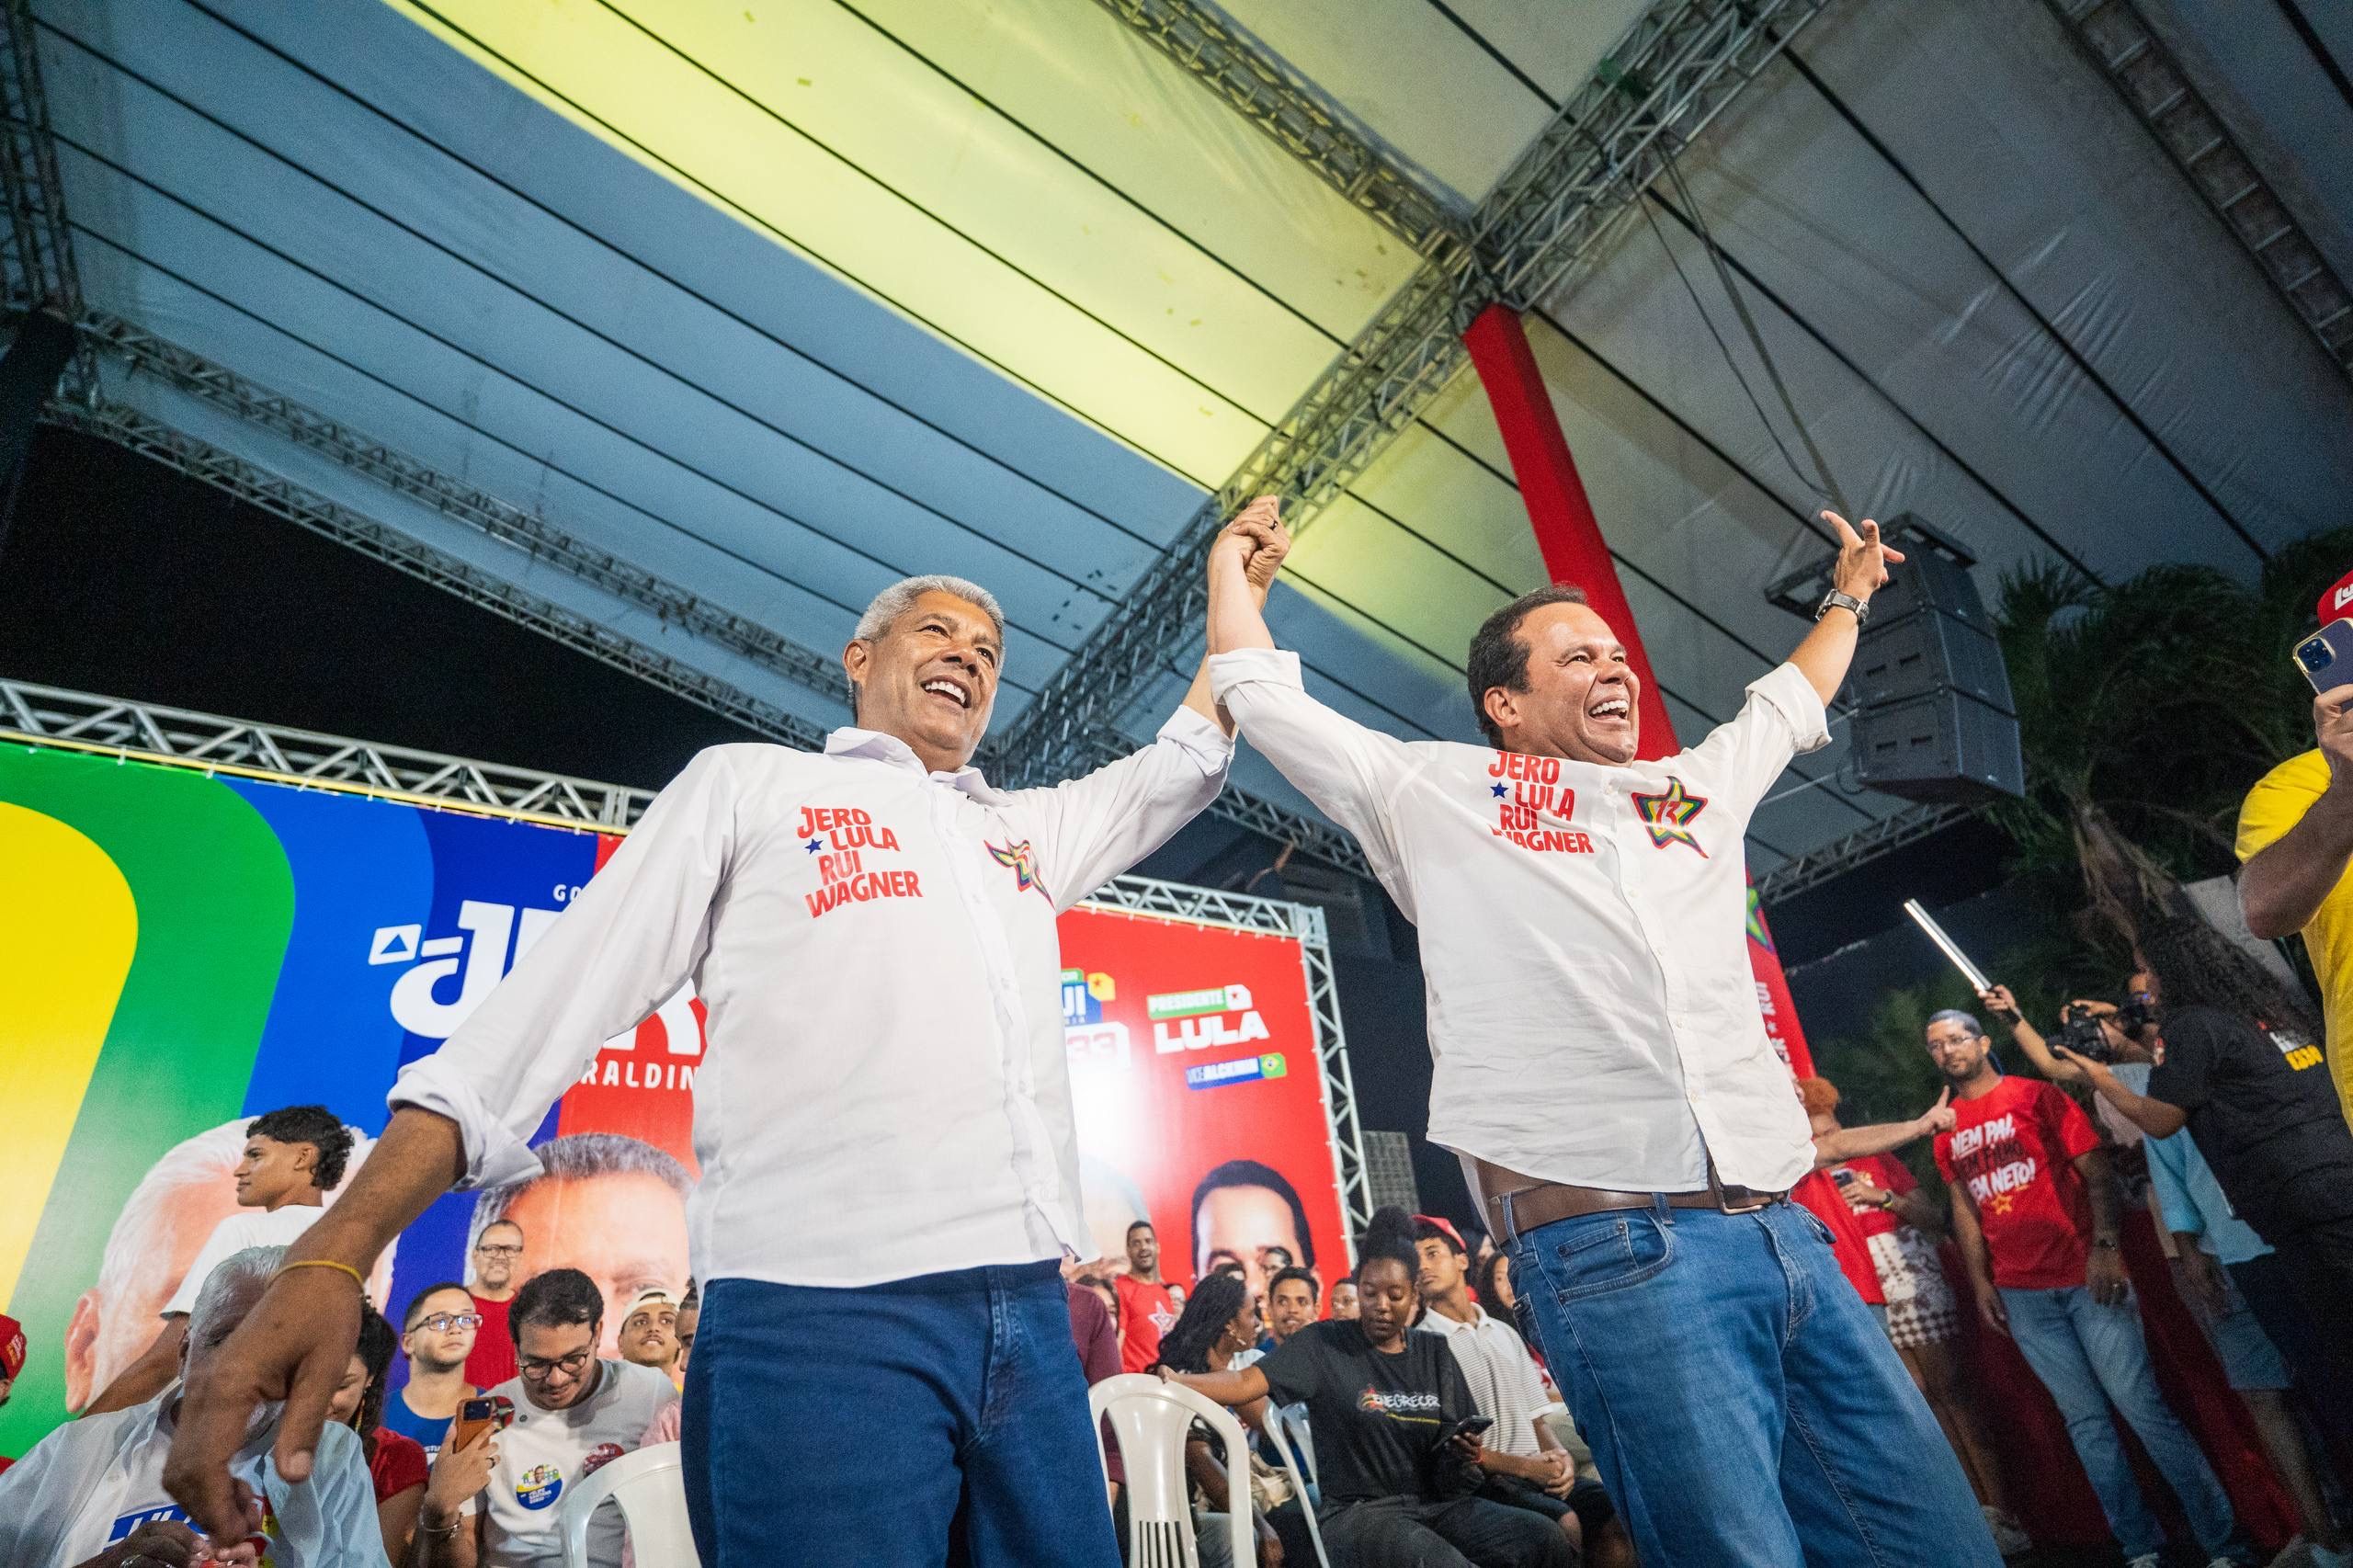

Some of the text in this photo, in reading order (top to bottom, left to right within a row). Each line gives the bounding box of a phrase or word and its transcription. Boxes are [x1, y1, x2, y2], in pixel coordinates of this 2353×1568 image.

[1488, 751, 1561, 785] JERO
[1499, 804, 1539, 831] RUI
[1515, 782, 1575, 822] LULA
[797, 806, 872, 838] JERO
[830, 825, 901, 851] LULA
[817, 849, 862, 886] RUI
[804, 870, 924, 918] WAGNER
[1154, 1010, 1270, 1054] LULA
[1950, 1125, 1984, 1160] NEM
[1991, 1157, 2036, 1196] NETO!
